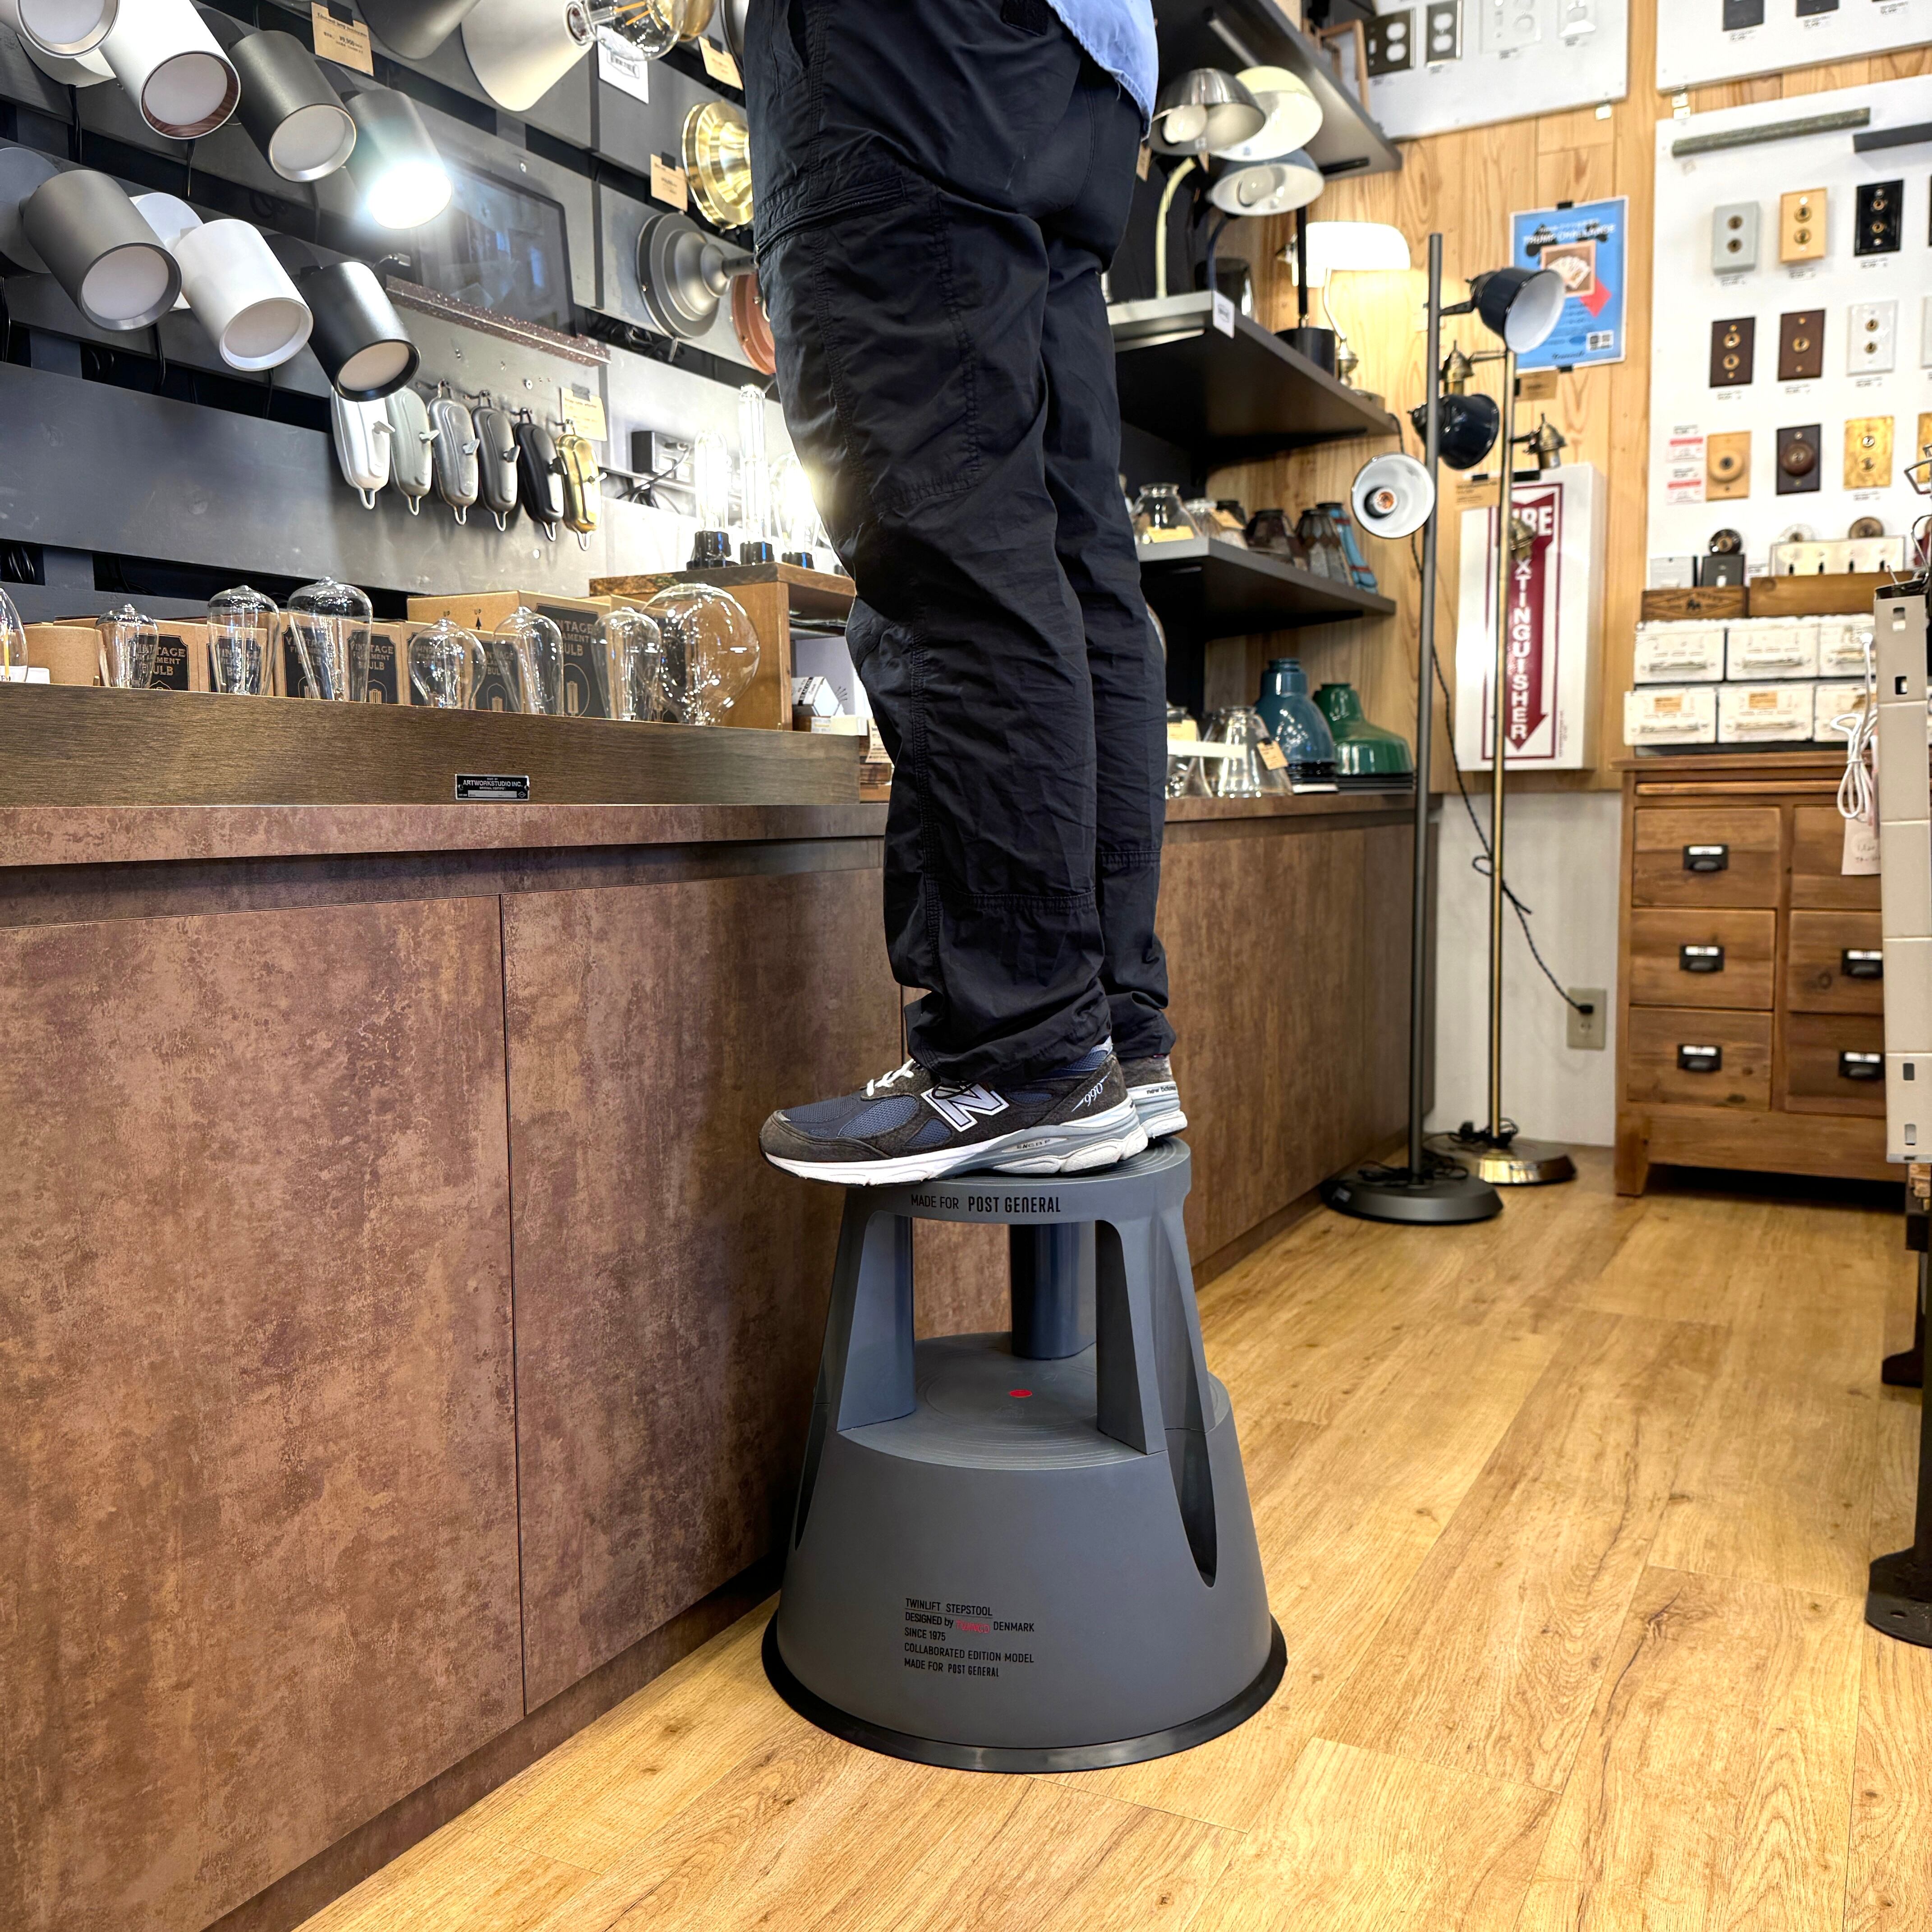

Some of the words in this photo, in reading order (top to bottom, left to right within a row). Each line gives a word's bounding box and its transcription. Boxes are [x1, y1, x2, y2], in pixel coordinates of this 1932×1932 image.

[564, 642, 584, 657] ULB
[1510, 559, 1532, 740] XTINGUISHER
[1084, 1082, 1103, 1107] 990
[911, 1194, 937, 1208] MADE
[940, 1196, 959, 1209] FOR
[969, 1196, 999, 1212] POST
[1005, 1197, 1061, 1213] GENERAL
[906, 1598, 941, 1611] TWINLIFT
[946, 1603, 993, 1616] STEPSTOOL
[905, 1612, 942, 1625] DESIGNED
[944, 1617, 954, 1628] by
[994, 1621, 1035, 1632] DENMARK
[905, 1627, 927, 1638] SINCE
[930, 1631, 946, 1641] 1975
[905, 1642, 965, 1658] COLLABORATED
[968, 1651, 1001, 1661] EDITION
[1005, 1653, 1034, 1663] MODEL
[904, 1658, 925, 1669] MADE
[928, 1661, 943, 1672] FOR
[948, 1664, 965, 1674] POST
[968, 1667, 999, 1677] GENERAL
